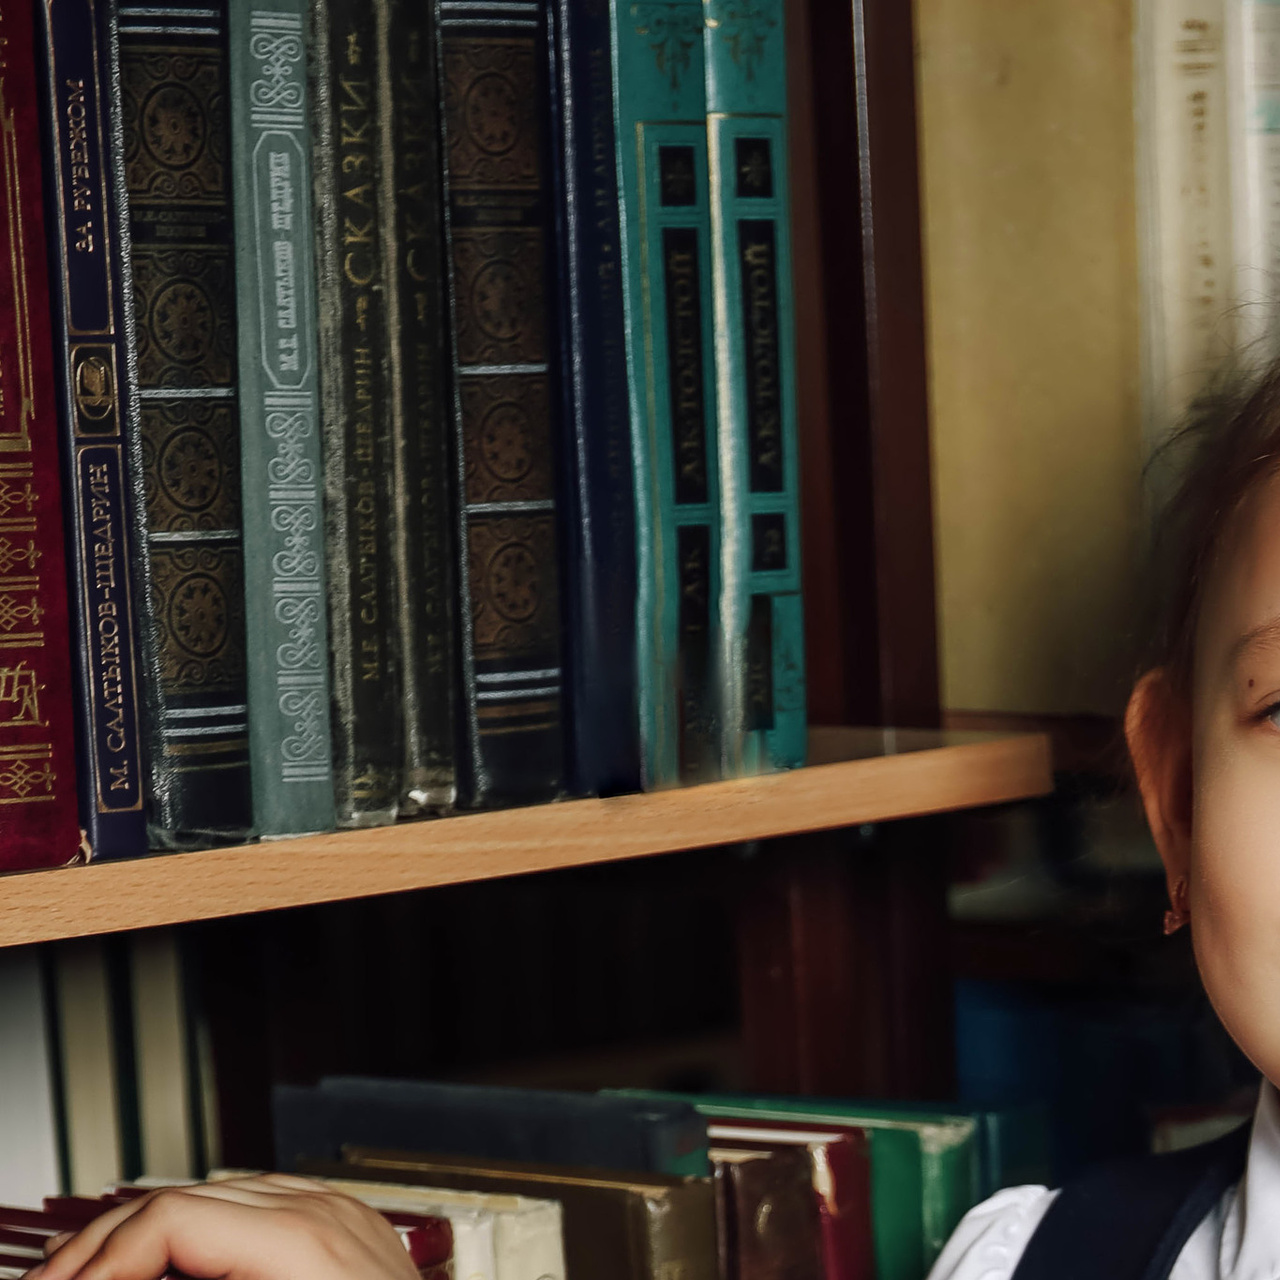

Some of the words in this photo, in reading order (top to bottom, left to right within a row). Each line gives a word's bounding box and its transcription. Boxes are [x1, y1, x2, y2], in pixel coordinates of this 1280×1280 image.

[65, 78, 92, 211] РУБЕЖОМ
[338, 71, 375, 287] СКАЗКИ
[74, 220, 94, 253] ЗА
[89, 463, 126, 753] САЛТЫКОВ-ЩЕДРИН
[108, 759, 130, 790] М.
